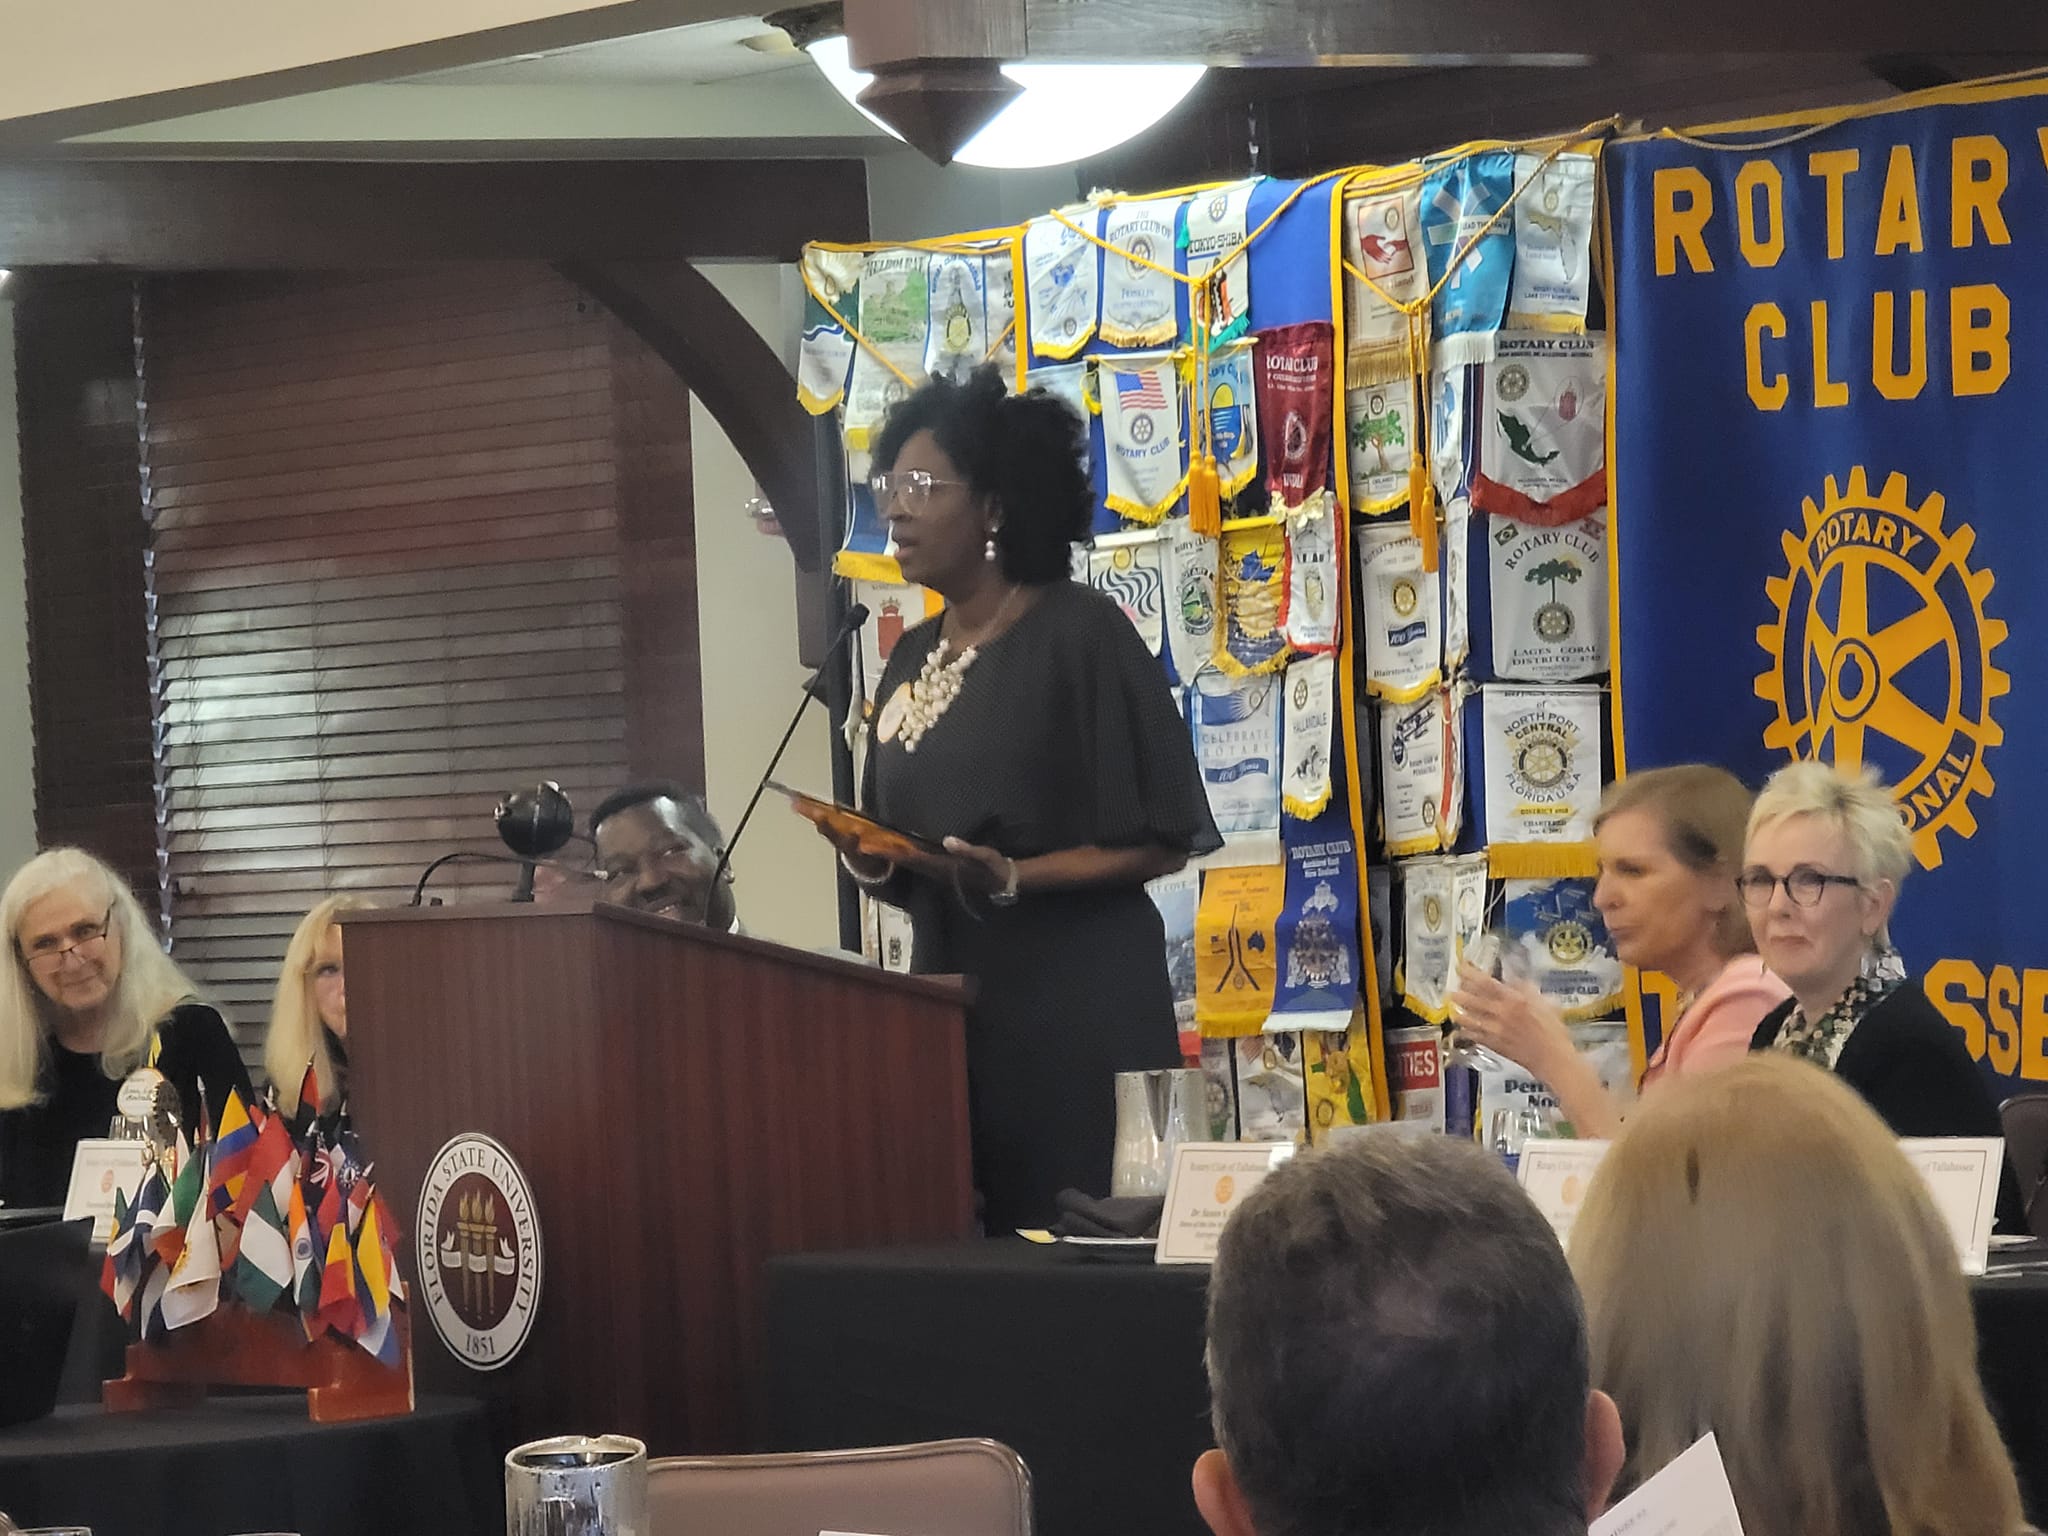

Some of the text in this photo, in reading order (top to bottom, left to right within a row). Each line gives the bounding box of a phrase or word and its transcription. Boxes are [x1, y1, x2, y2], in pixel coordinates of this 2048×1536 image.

[1654, 127, 2048, 276] ROTAR
[1140, 220, 1161, 234] CLUB
[1500, 339, 1555, 349] ROTARY
[1744, 284, 2011, 411] CLUB
[1150, 436, 1171, 456] CLUB
[1816, 511, 1923, 561] ROTARY
[1505, 531, 1600, 570] ROTARY CLUB
[1504, 712, 1580, 736] NORTH PORT
[1515, 722, 1568, 740] CENTRAL
[1202, 729, 1269, 744] CELEBRATE
[1203, 743, 1269, 758] ROTARY
[1505, 773, 1554, 803] FLORIDA
[1577, 986, 1600, 995] CLUB
[423, 1147, 534, 1320] FLORIDA STATE UNIVERSITY
[466, 1334, 496, 1356] 1851
